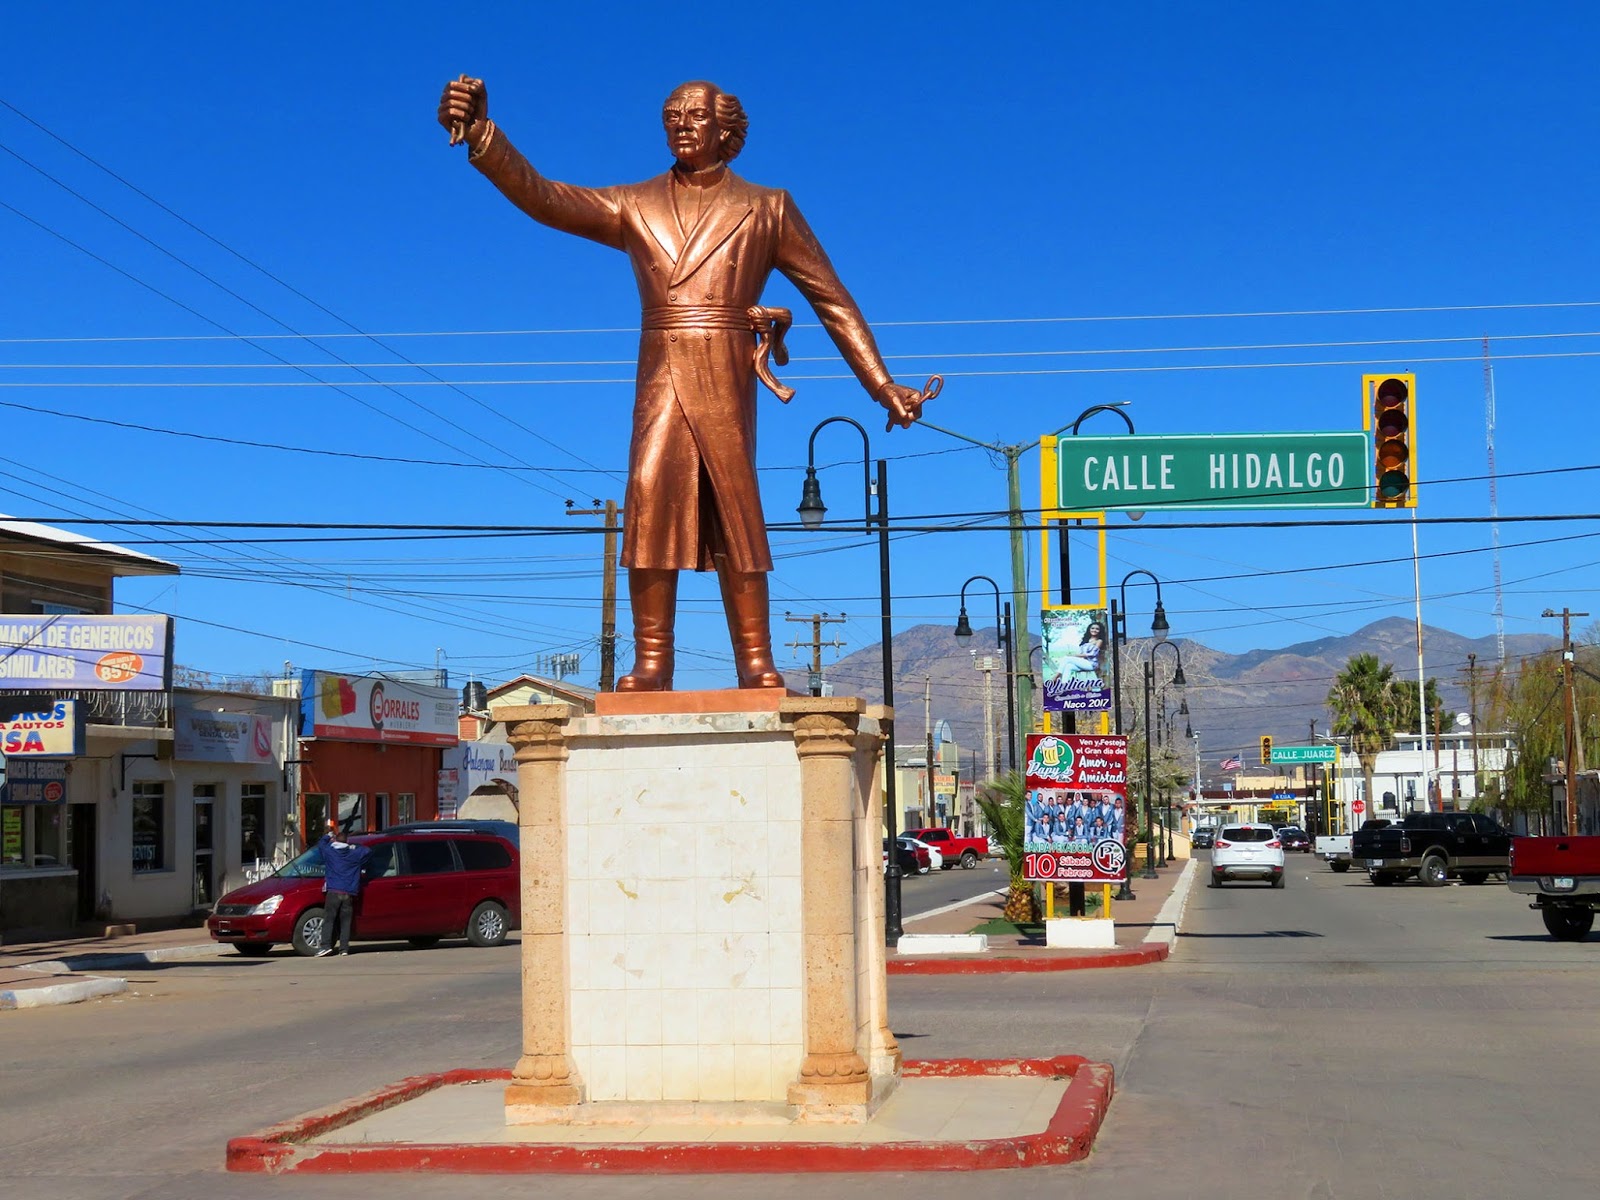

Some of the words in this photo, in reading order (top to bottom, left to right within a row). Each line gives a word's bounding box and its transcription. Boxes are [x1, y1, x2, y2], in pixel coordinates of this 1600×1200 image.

[1083, 454, 1176, 491] CALLE
[1209, 452, 1345, 489] HIDALGO
[47, 625, 67, 648] DE
[70, 625, 155, 650] GENERICOS
[0, 654, 76, 679] SIMILARES
[101, 661, 138, 681] 85%
[1063, 700, 1086, 709] Naco
[1088, 699, 1109, 708] 2017
[12, 721, 65, 730] AUTOS
[0, 730, 45, 753] SA
[1079, 738, 1093, 746] Ven
[1100, 738, 1126, 748] Festeja
[1076, 747, 1083, 755] el
[1084, 747, 1102, 755] Gran
[1115, 747, 1127, 755] del
[1272, 751, 1298, 760] CALLE
[1302, 749, 1335, 759] JUAREZ
[1078, 755, 1108, 768] Amor
[1078, 770, 1126, 783] Amistad
[1024, 842, 1050, 853] BANDA
[1052, 842, 1094, 853] PEKADORA
[1026, 854, 1056, 878] 10
[1057, 867, 1093, 878] Febrero
